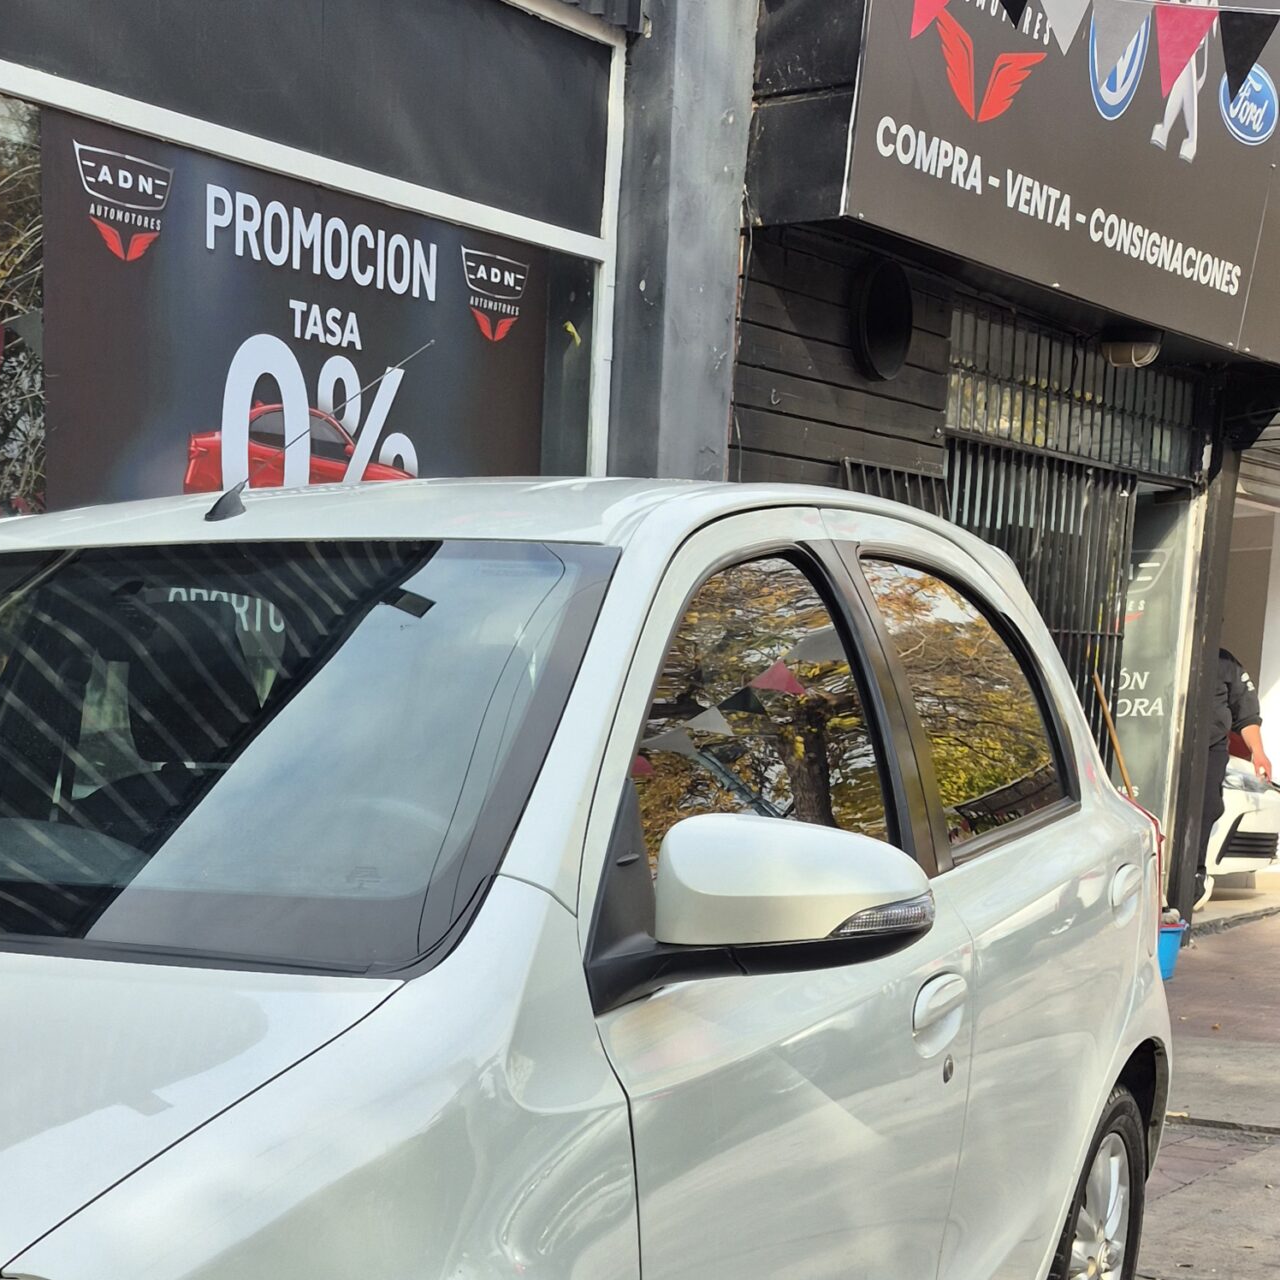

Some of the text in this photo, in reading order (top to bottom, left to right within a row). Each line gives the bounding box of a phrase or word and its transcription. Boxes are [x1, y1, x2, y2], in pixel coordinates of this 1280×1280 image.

[97, 164, 153, 195] ADN
[89, 202, 162, 231] AUTOMOTORES
[876, 116, 982, 195] COMPRA
[1006, 168, 1071, 230] VENTA
[1089, 207, 1242, 296] CONSIGNACIONES
[205, 183, 438, 302] PROMOCION
[476, 264, 515, 287] ADN
[289, 298, 363, 351] TASA
[469, 295, 520, 316] AUTOMOTORES
[221, 333, 419, 492] 0%
